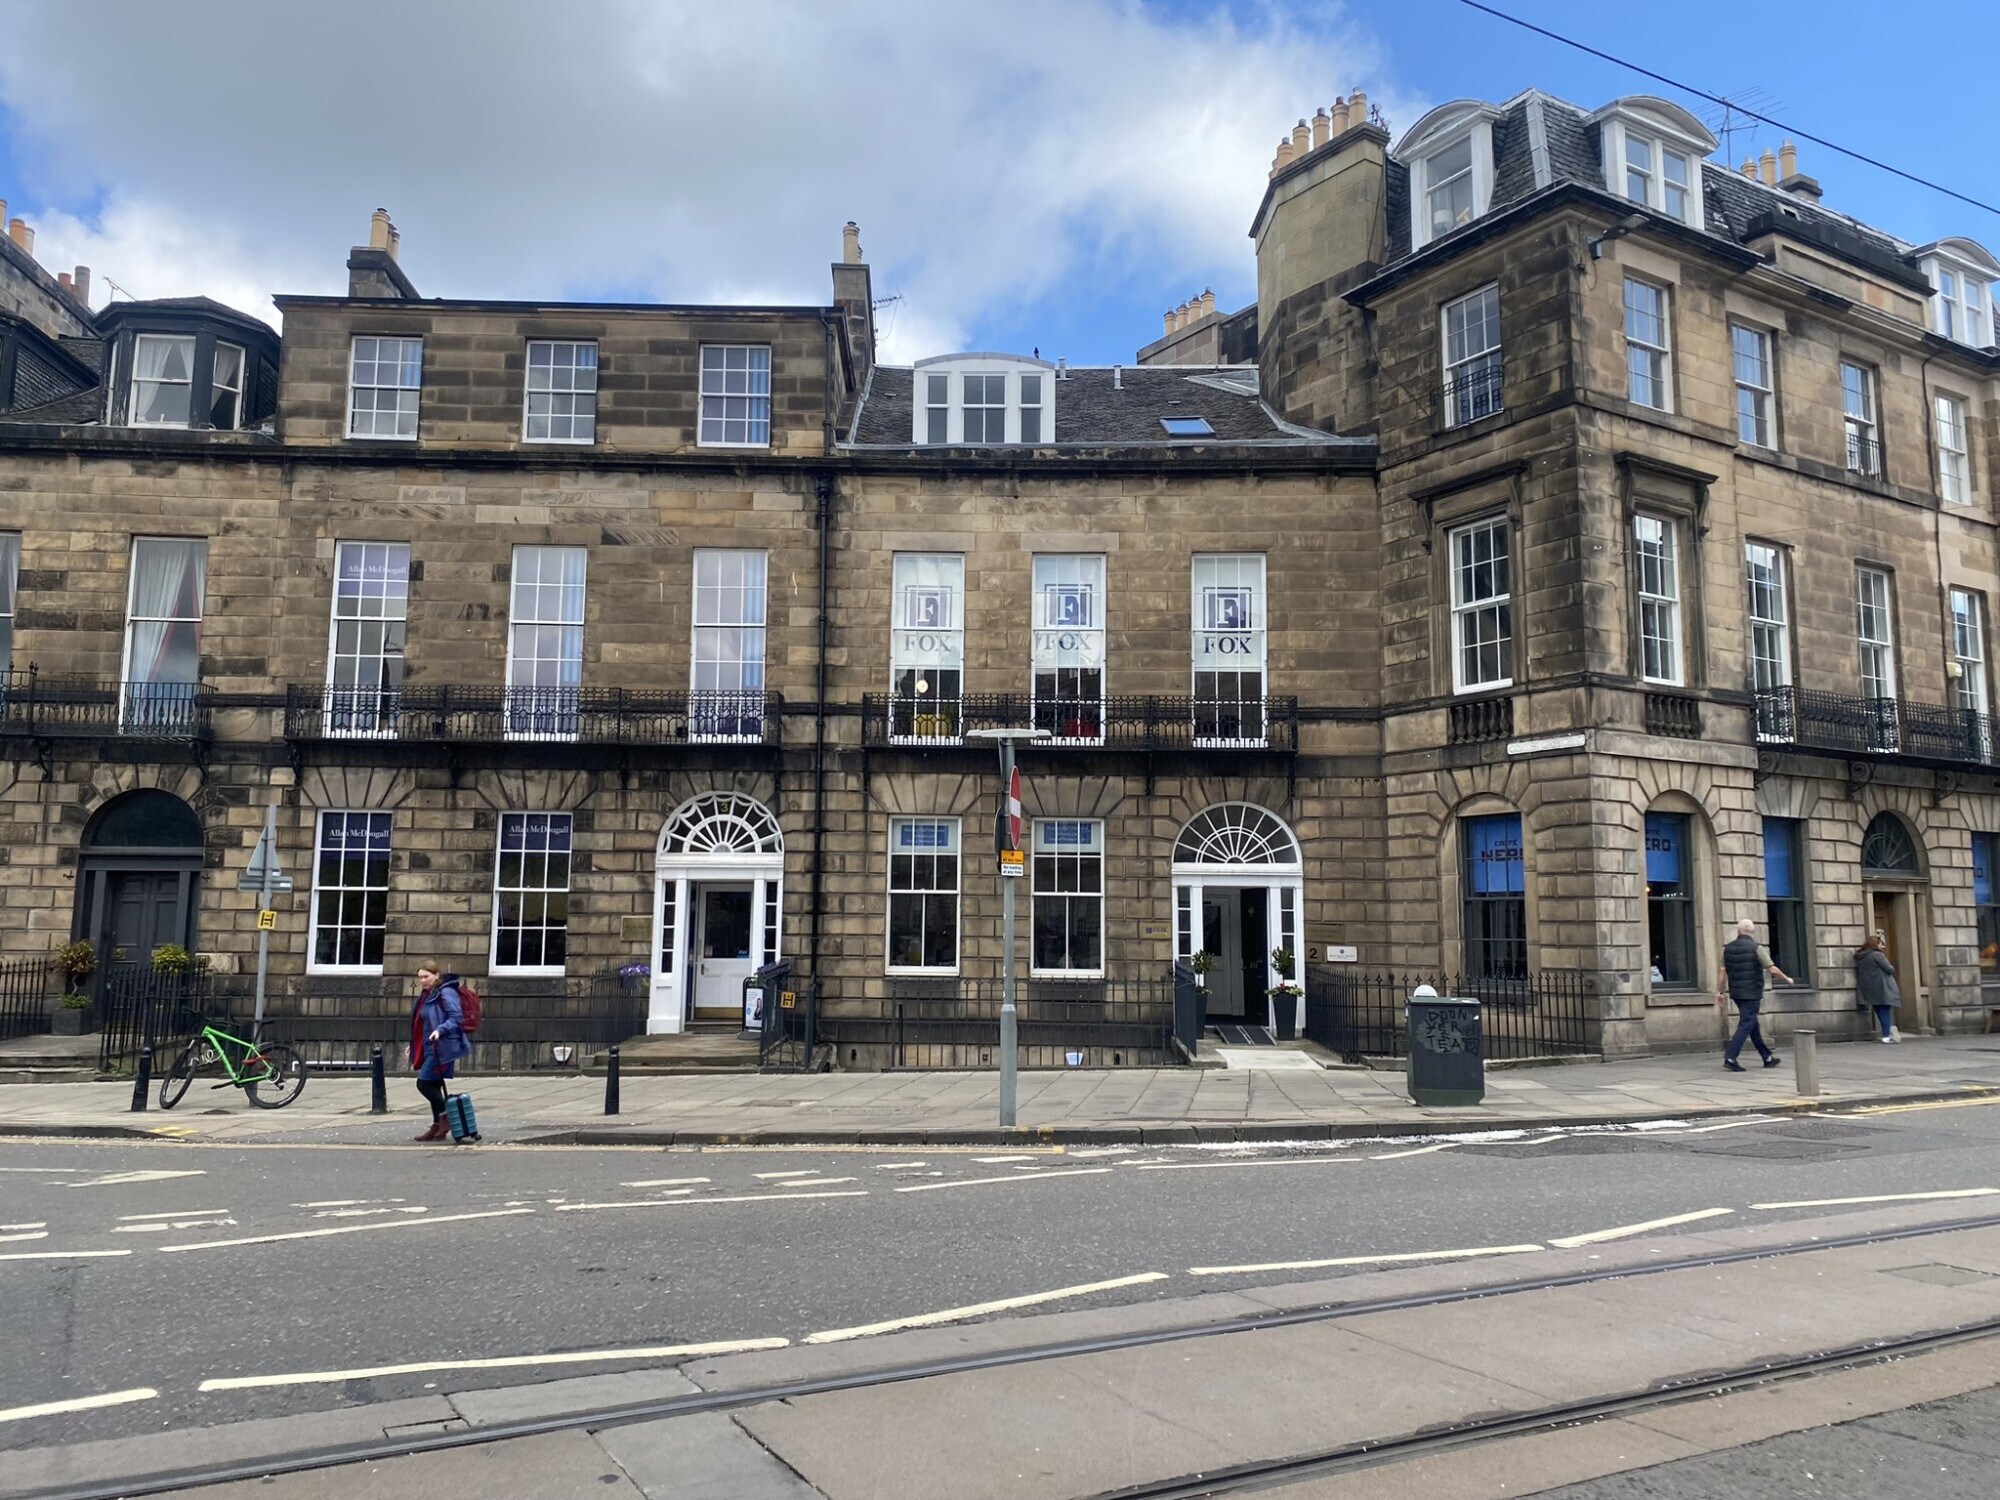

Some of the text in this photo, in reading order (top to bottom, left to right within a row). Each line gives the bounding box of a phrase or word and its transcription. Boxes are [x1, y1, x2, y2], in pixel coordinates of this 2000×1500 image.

[347, 565, 367, 573] Allan
[903, 634, 951, 652] FOX
[1043, 633, 1091, 651] FOX
[1203, 636, 1252, 654] FOX
[721, 802, 729, 812] 3
[329, 829, 349, 837] Allan
[509, 825, 529, 833] Allan
[1645, 838, 1671, 851] ERO
[260, 912, 275, 927] H
[1309, 948, 1318, 959] 2
[782, 992, 795, 1007] H
[1426, 1035, 1463, 1052] TEA
